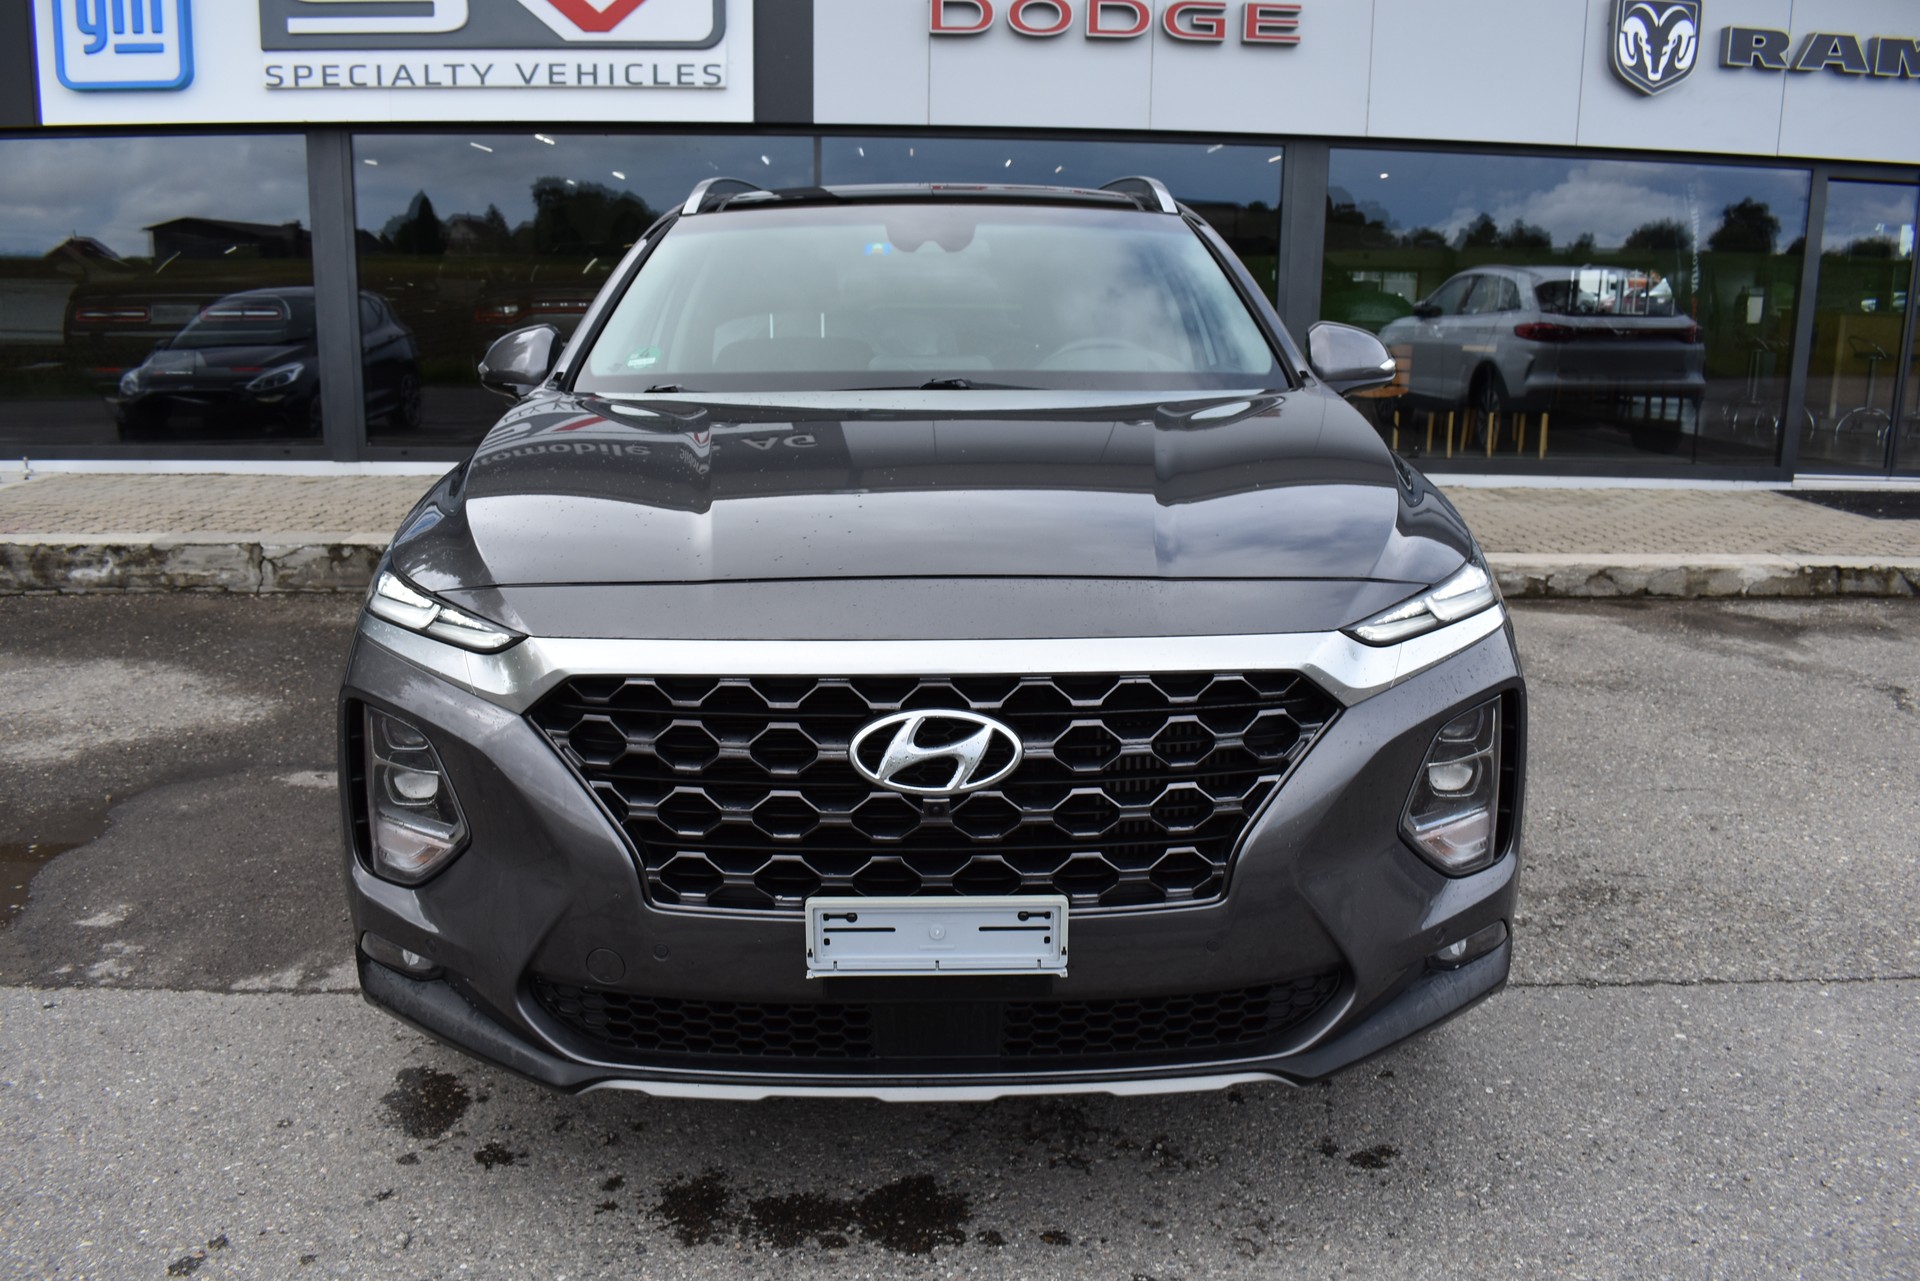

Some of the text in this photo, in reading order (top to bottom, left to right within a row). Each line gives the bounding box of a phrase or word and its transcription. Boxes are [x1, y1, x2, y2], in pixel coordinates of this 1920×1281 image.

[929, 0, 1301, 44] DODGE
[264, 63, 722, 88] SPECIALTY VEHICLES
